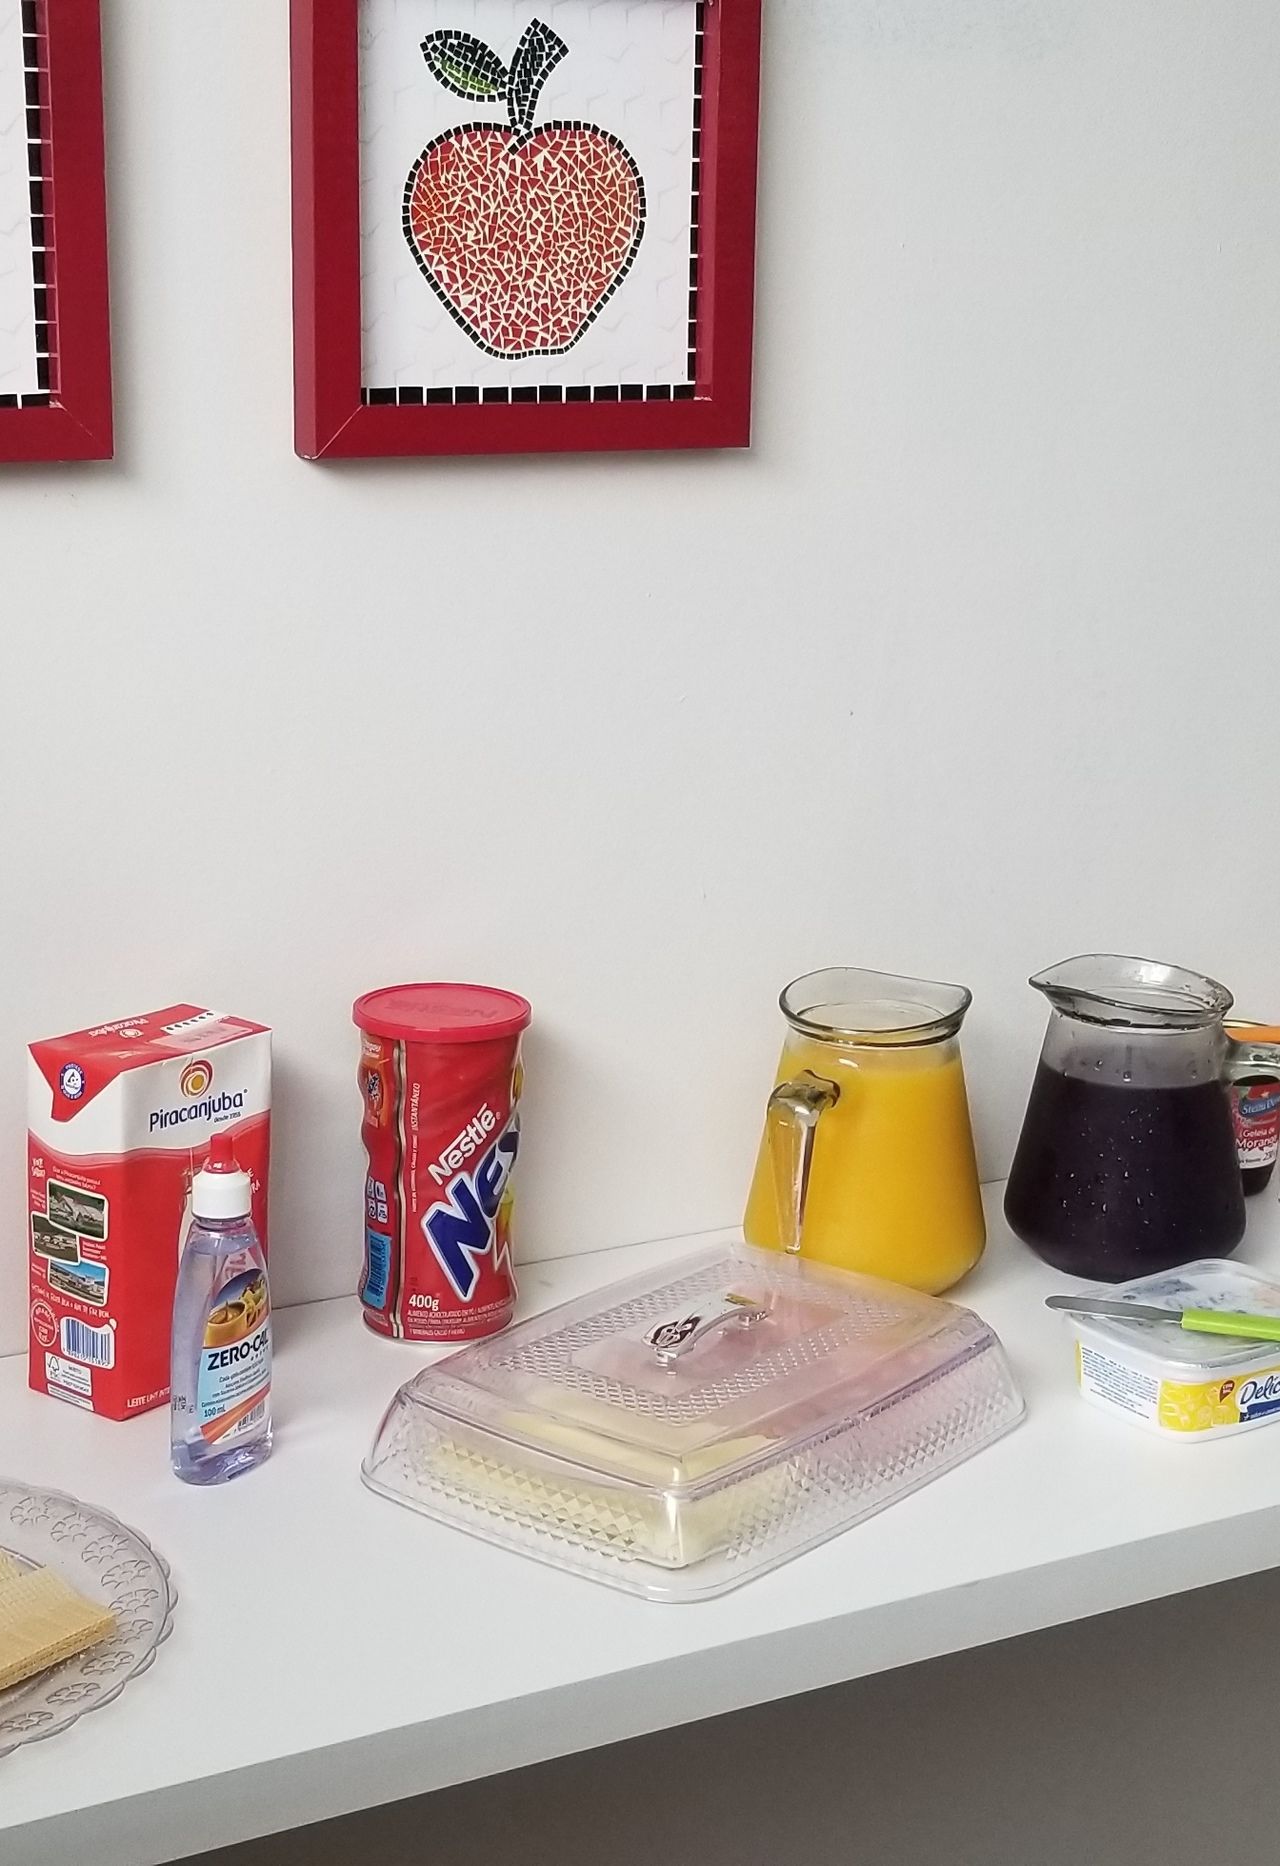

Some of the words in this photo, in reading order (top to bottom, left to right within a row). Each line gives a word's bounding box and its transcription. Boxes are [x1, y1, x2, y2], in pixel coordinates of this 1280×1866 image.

[149, 1091, 244, 1132] Piracanjuba
[427, 1102, 496, 1186] Nestlé
[408, 1294, 439, 1311] 400g
